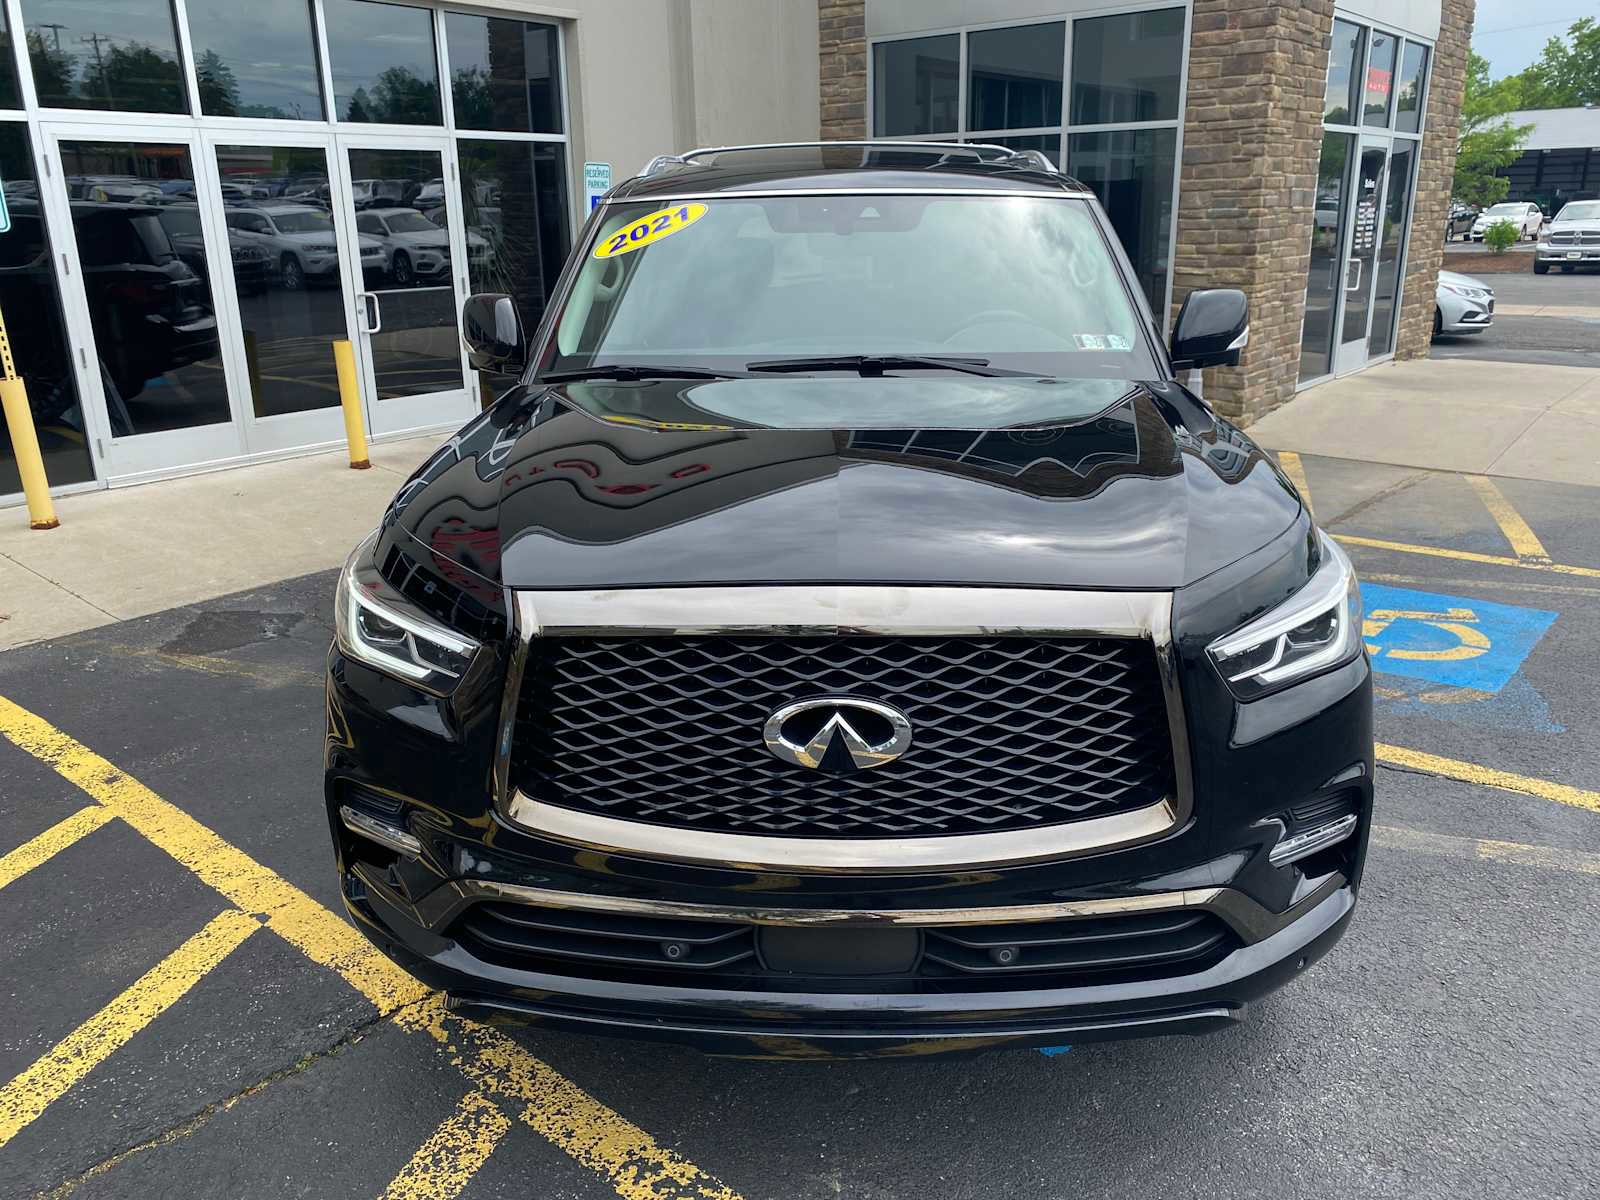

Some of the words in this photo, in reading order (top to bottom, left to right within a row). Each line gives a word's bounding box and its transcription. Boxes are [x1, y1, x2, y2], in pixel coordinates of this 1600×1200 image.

[585, 169, 609, 178] RESERVED
[587, 180, 609, 189] PARKING
[609, 206, 689, 254] 2021
